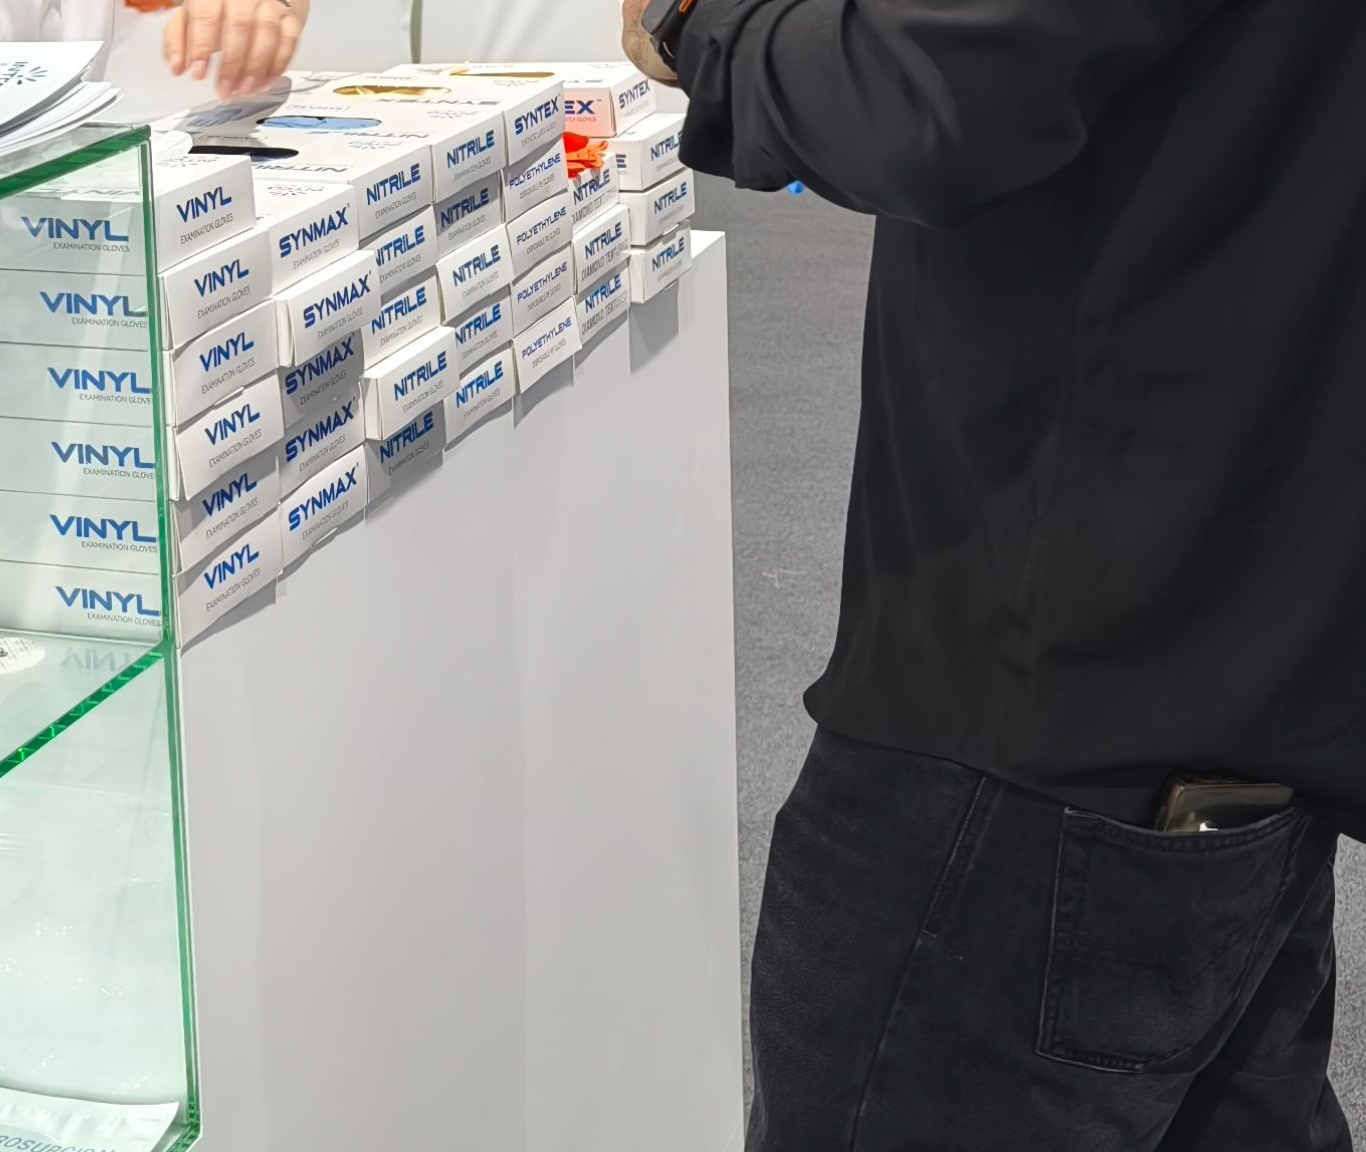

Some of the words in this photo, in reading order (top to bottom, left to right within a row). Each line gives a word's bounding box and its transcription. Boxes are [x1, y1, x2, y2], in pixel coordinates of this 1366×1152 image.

[619, 79, 650, 109] SYNTEX
[514, 96, 559, 136] SYNTEX
[446, 130, 495, 169] NITRILE
[367, 163, 421, 205] NITRILE
[509, 153, 561, 189] POLYETHYLENE
[573, 169, 610, 205] NITRILE
[176, 186, 232, 223] VINYL
[440, 188, 490, 228] NITRILE
[654, 181, 687, 214] NITRILE
[21, 216, 129, 242] VINYL
[279, 206, 349, 258] SYNMAX
[517, 206, 567, 246] POLYETHYLENE
[585, 221, 622, 259] NITRILE
[53, 241, 101, 251] EXAMINATION
[452, 244, 502, 287] NITRILE
[652, 237, 684, 272] NITRILE
[194, 259, 250, 298] VINYL
[517, 261, 568, 303] POLYETHYLENE
[585, 274, 621, 313] NITRILE
[39, 291, 148, 318] VINYL
[71, 317, 120, 327] EXAMINATION
[304, 276, 371, 329] SYNMAX
[371, 286, 427, 334] NITRILE
[455, 303, 502, 346] NITRILE
[522, 316, 572, 360] POLYETHYLENE
[199, 332, 255, 373] VINYL
[285, 338, 355, 396] SYNMAX
[47, 367, 151, 394] VINYL
[394, 350, 448, 401] NITRILE
[456, 360, 504, 409] NITRILE
[79, 393, 128, 403] EXAMINATION
[204, 404, 260, 446] VINYL
[285, 401, 354, 463] SYNMAX
[380, 410, 434, 463] NITRILE
[50, 441, 156, 469] VINYL
[83, 466, 132, 478] EXAMINATION
[132, 469, 155, 480] GLOVE
[202, 473, 258, 517] VINYL
[288, 468, 357, 532] SYNMAX
[49, 514, 157, 543] VINYL
[81, 540, 130, 551] EXAMINATION
[203, 544, 260, 590] VINYL
[55, 586, 161, 617] VINYL
[86, 612, 135, 624] EXAMINATION
